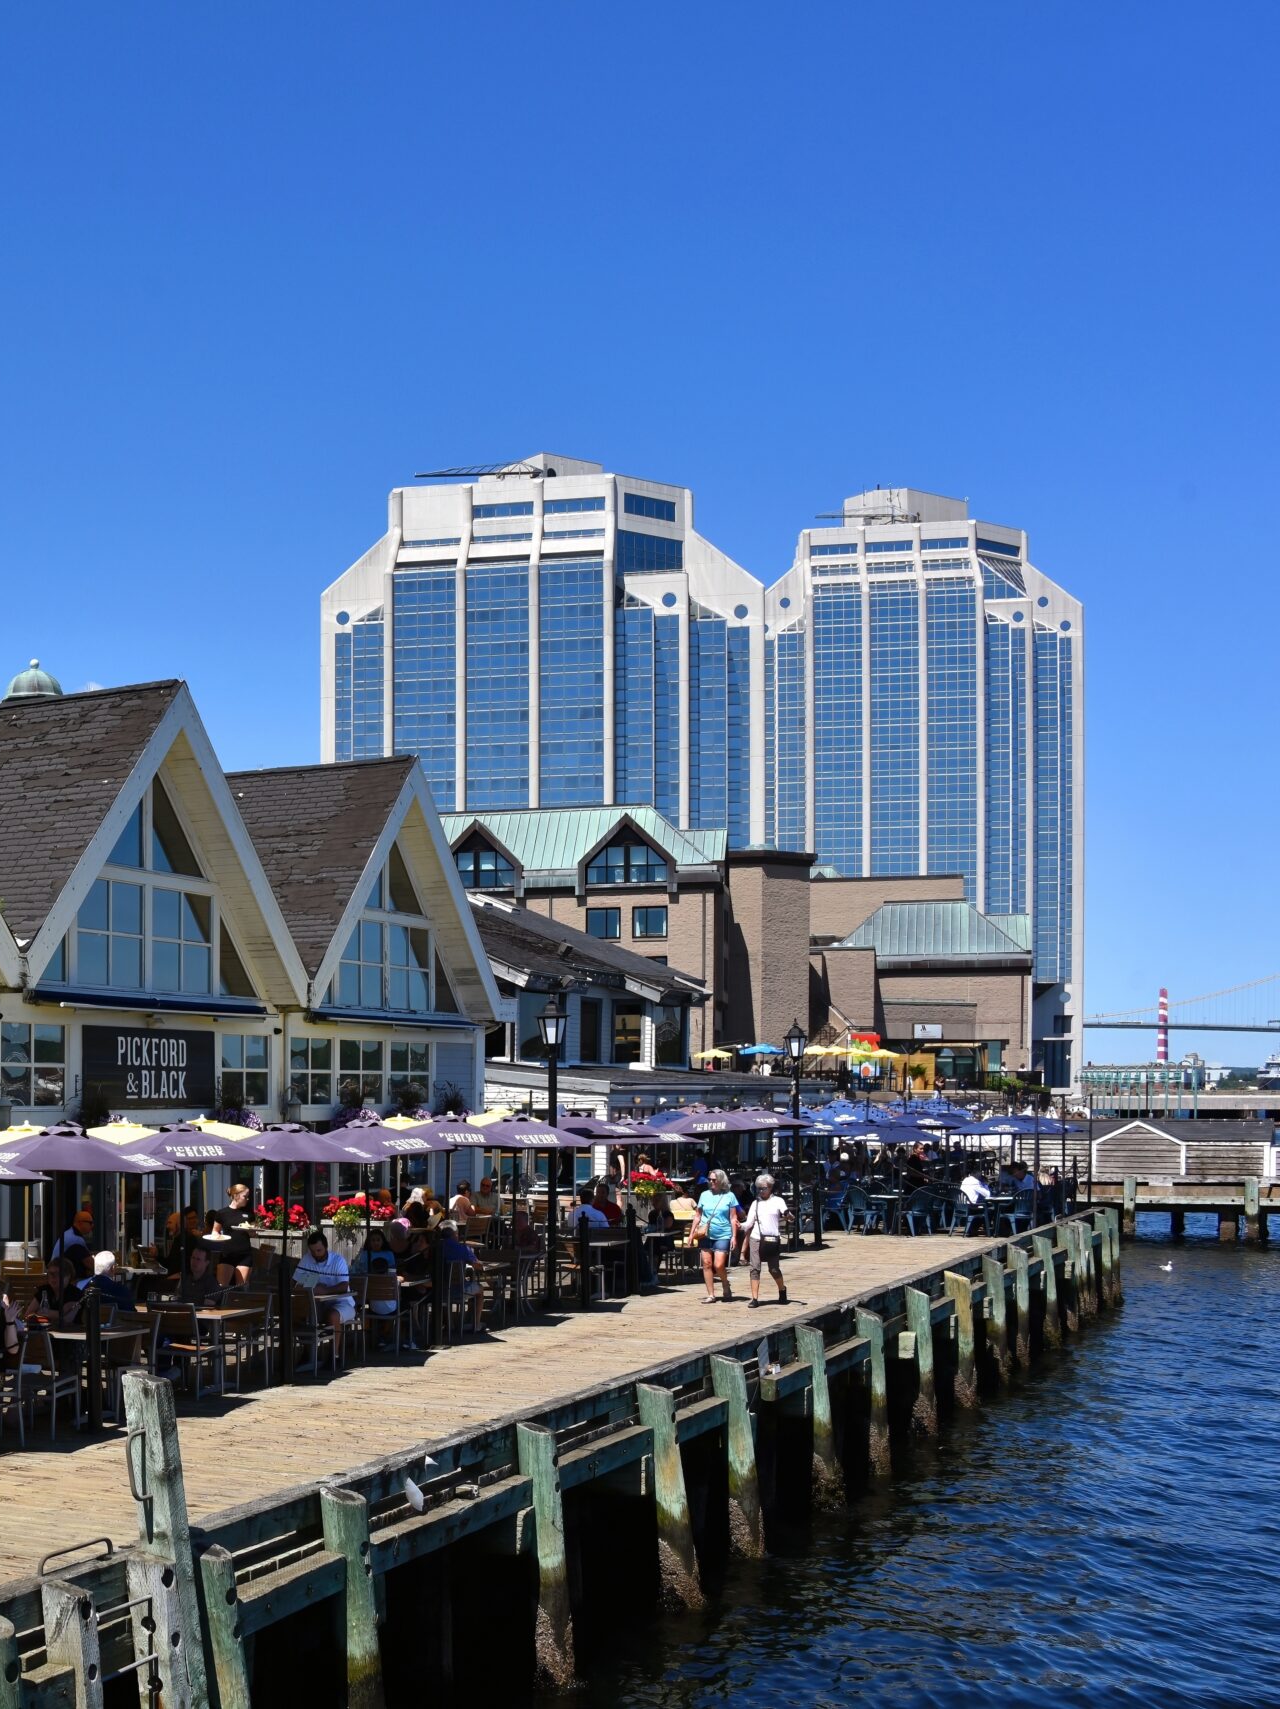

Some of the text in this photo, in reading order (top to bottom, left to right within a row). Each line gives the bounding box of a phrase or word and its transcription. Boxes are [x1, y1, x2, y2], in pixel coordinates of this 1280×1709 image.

[117, 1036, 187, 1067] PICKFORD
[126, 1070, 187, 1099] & BLACK
